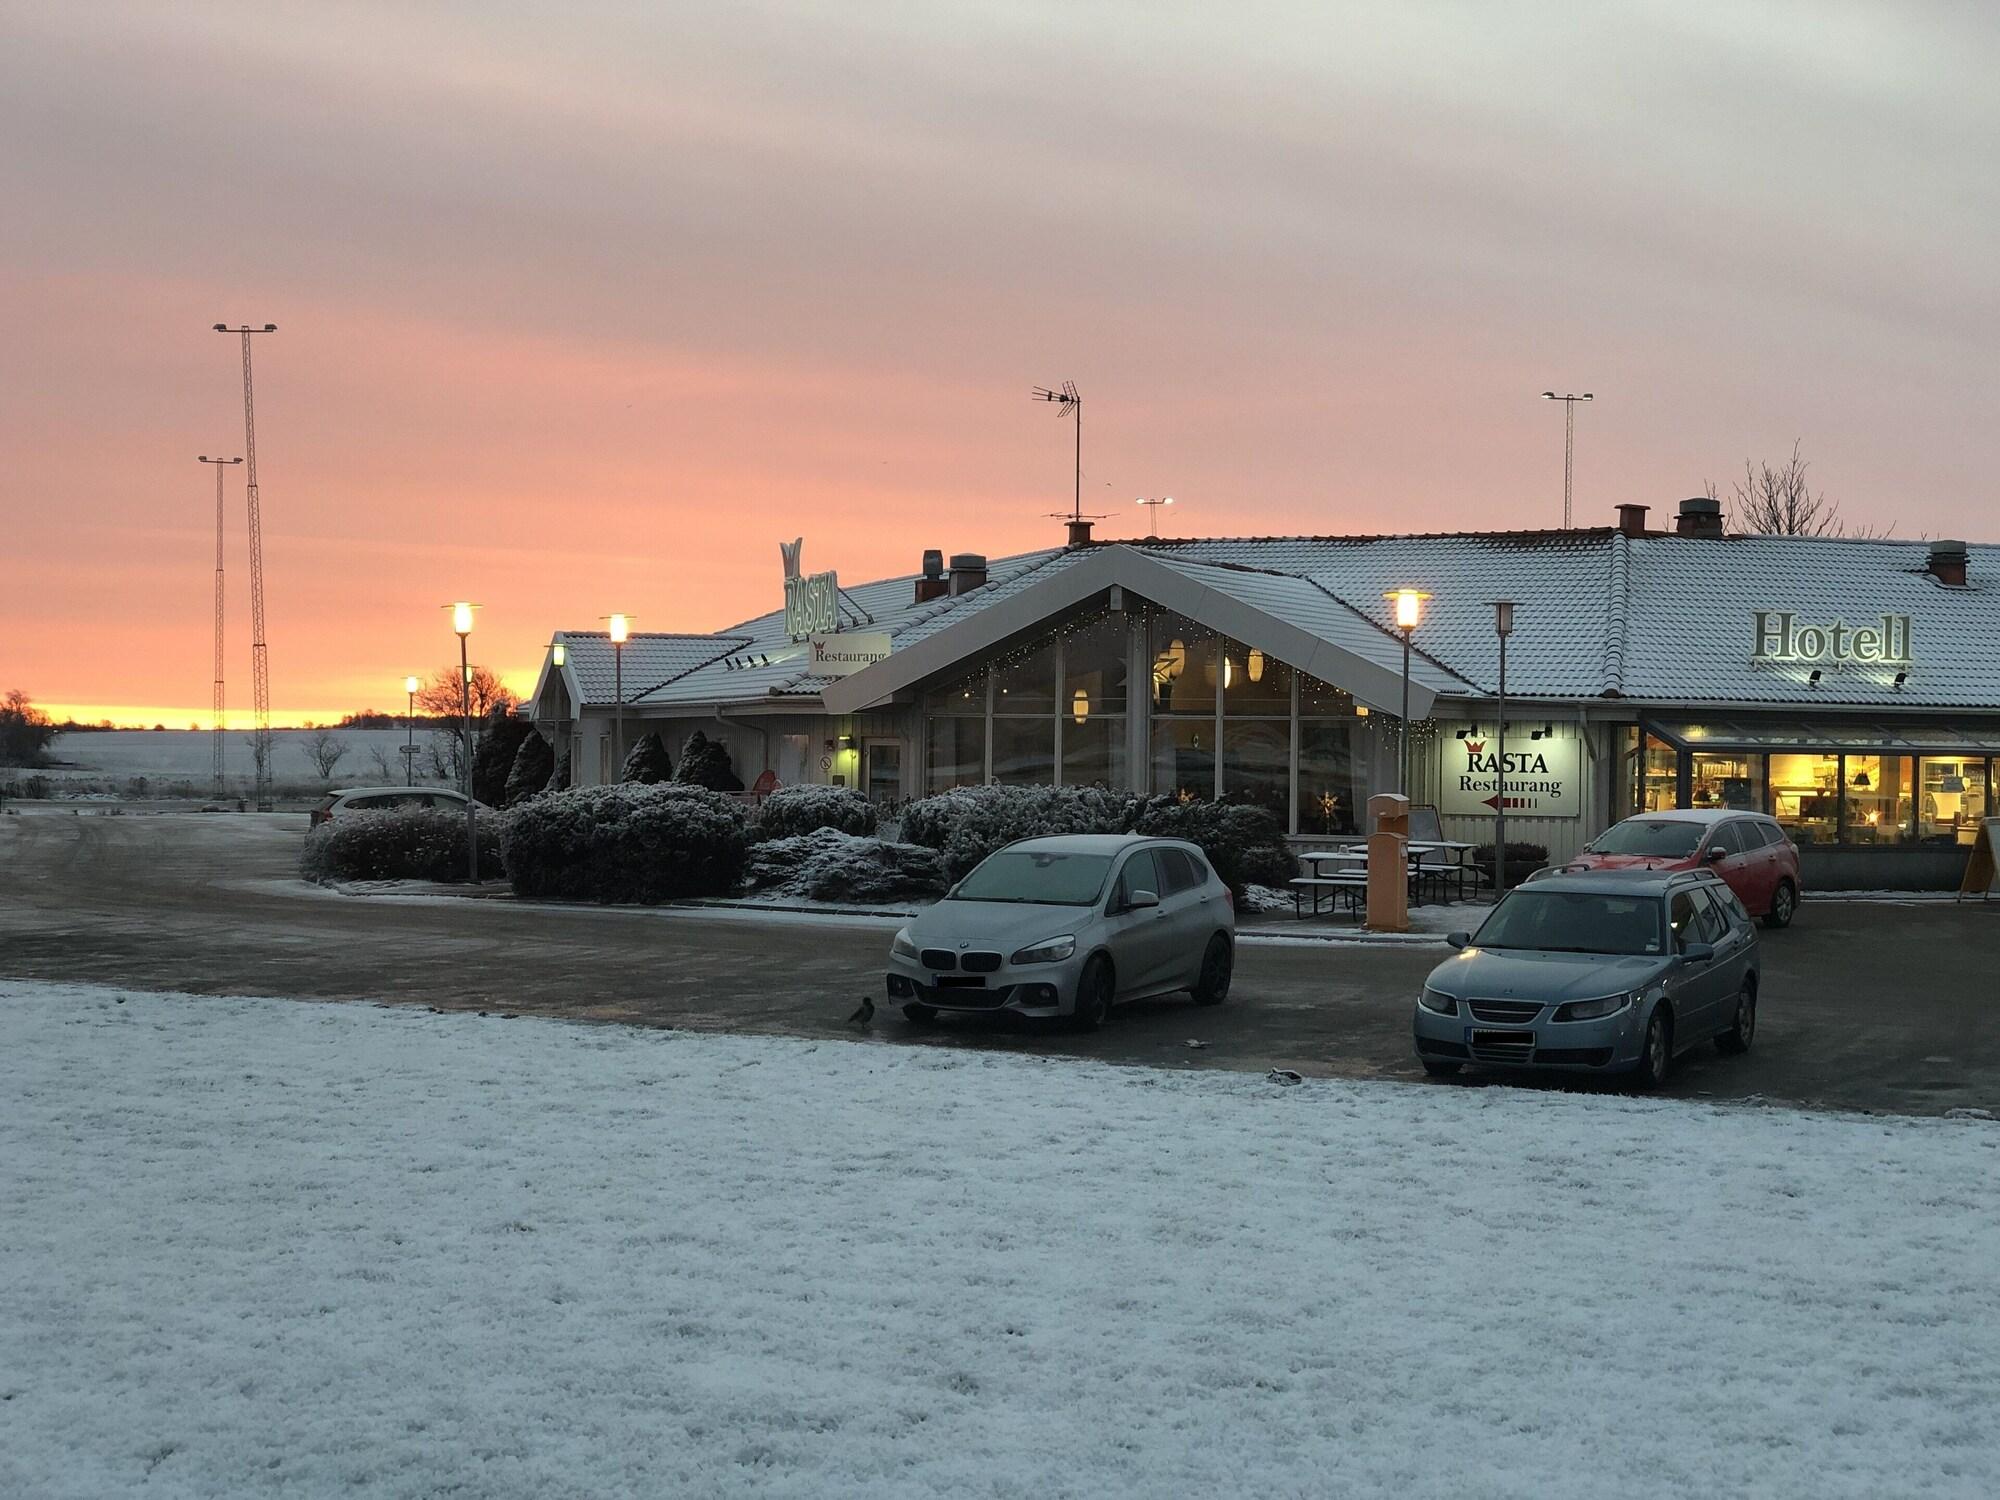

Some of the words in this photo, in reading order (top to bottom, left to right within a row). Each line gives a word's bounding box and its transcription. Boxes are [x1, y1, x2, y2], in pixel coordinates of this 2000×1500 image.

[785, 573, 838, 635] RASTA
[1750, 610, 1914, 663] Hotell
[1466, 753, 1549, 773] RASTA
[1459, 776, 1562, 798] Restaurang
